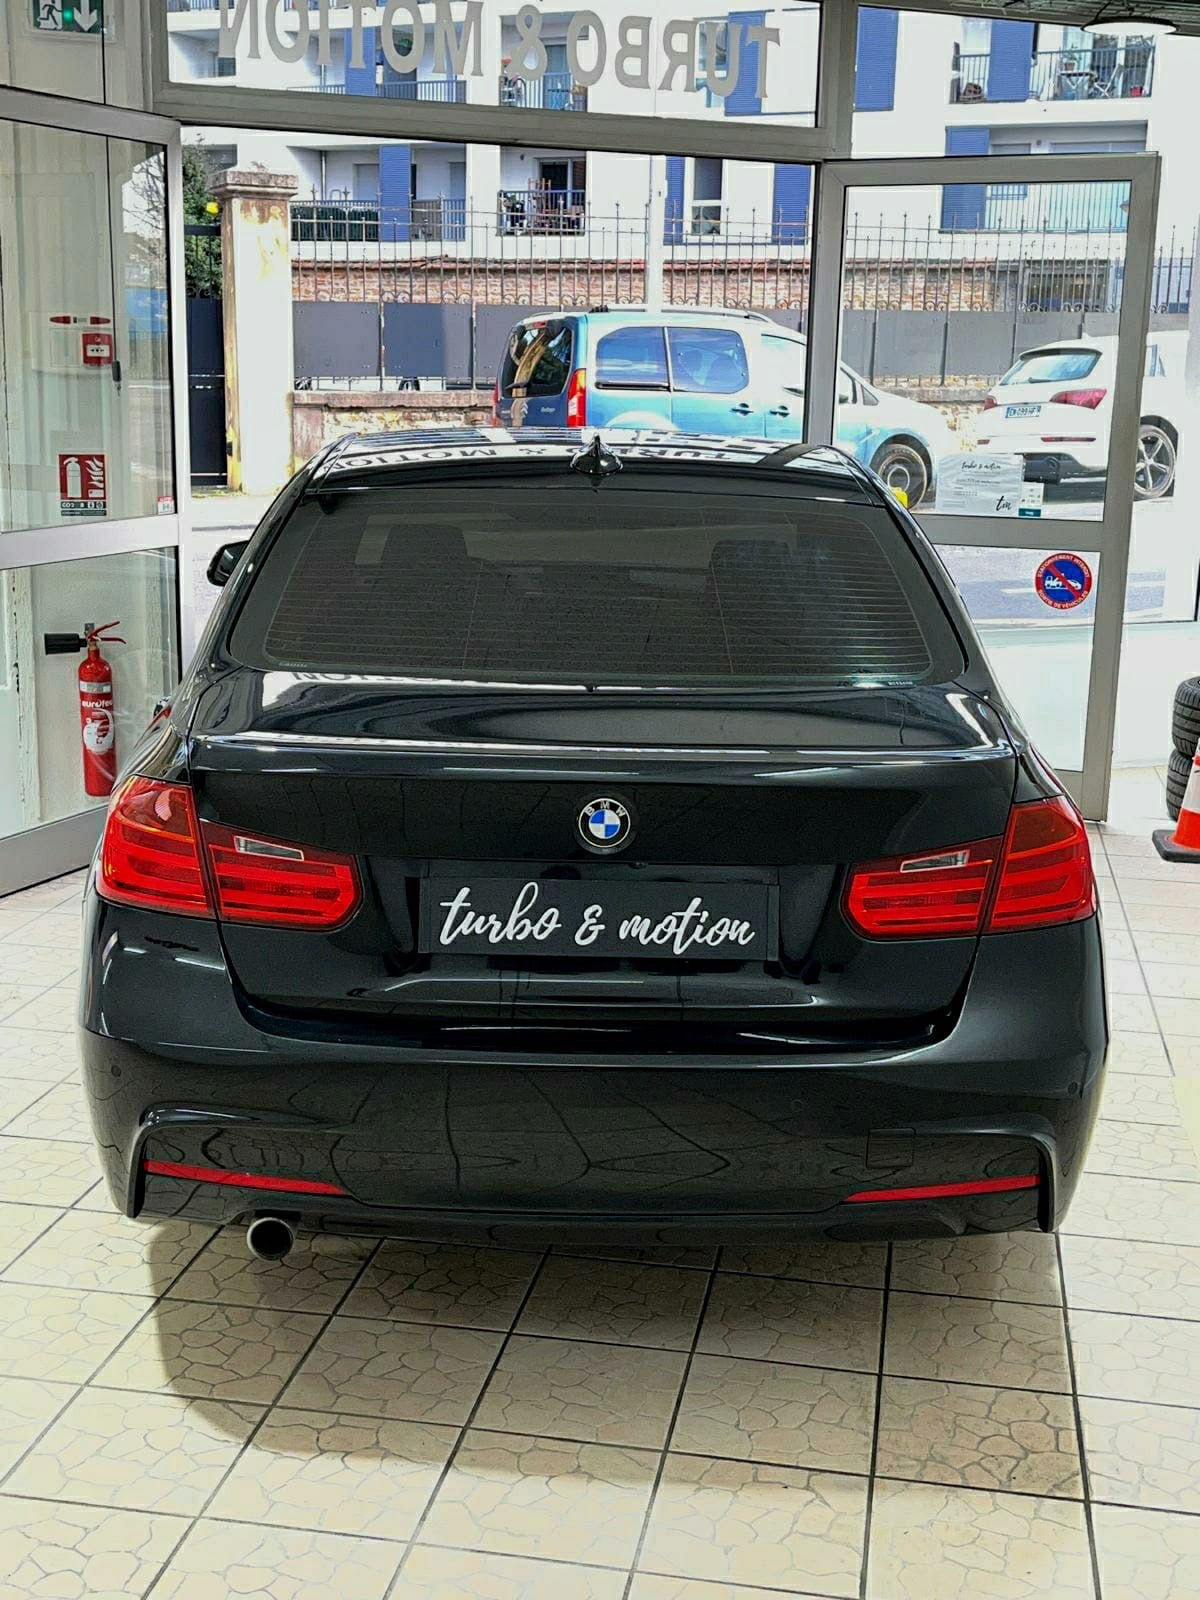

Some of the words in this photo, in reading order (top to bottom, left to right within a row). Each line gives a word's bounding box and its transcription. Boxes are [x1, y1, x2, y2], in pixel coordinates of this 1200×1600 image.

[584, 800, 626, 817] BMW
[439, 881, 562, 946] turbo
[574, 904, 606, 946] &
[618, 897, 755, 955] motion
